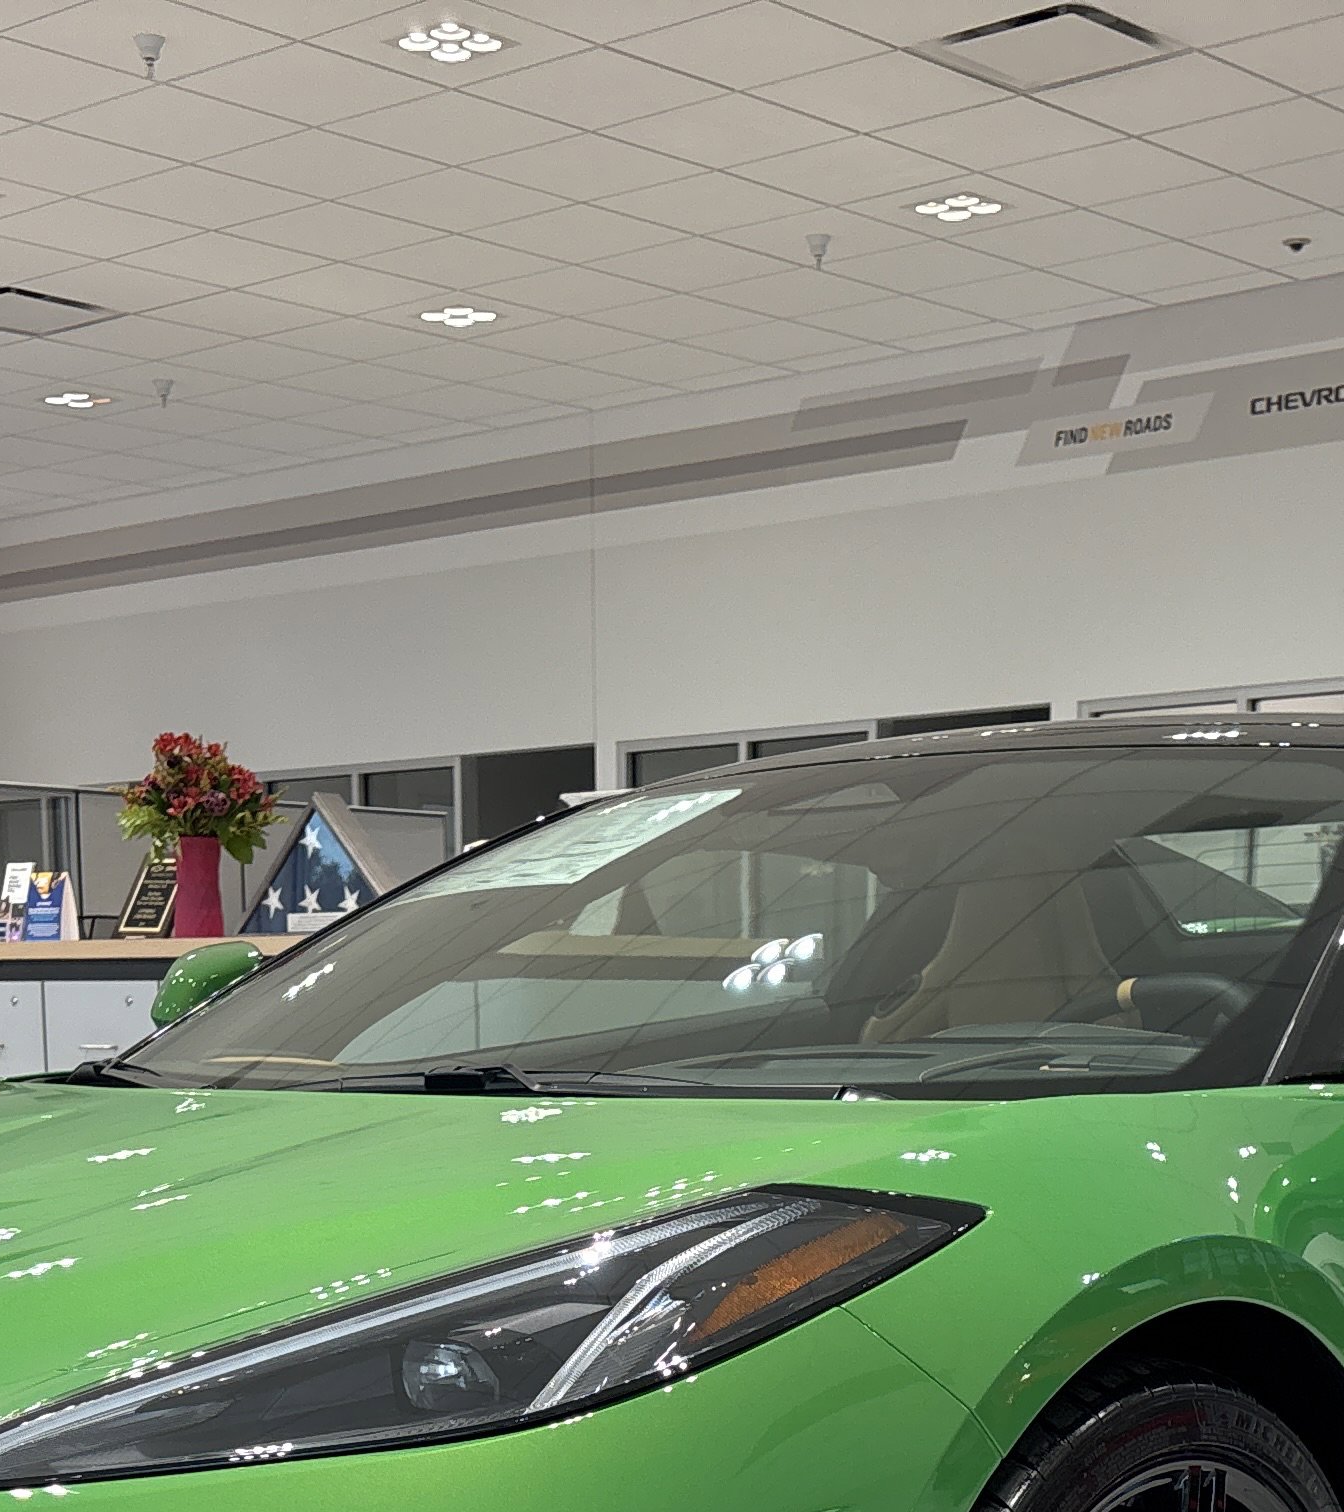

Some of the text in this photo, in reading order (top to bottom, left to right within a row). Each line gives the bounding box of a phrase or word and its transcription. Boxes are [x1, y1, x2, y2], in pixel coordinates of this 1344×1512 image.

[1054, 413, 1173, 448] FIND NEW ROADS
